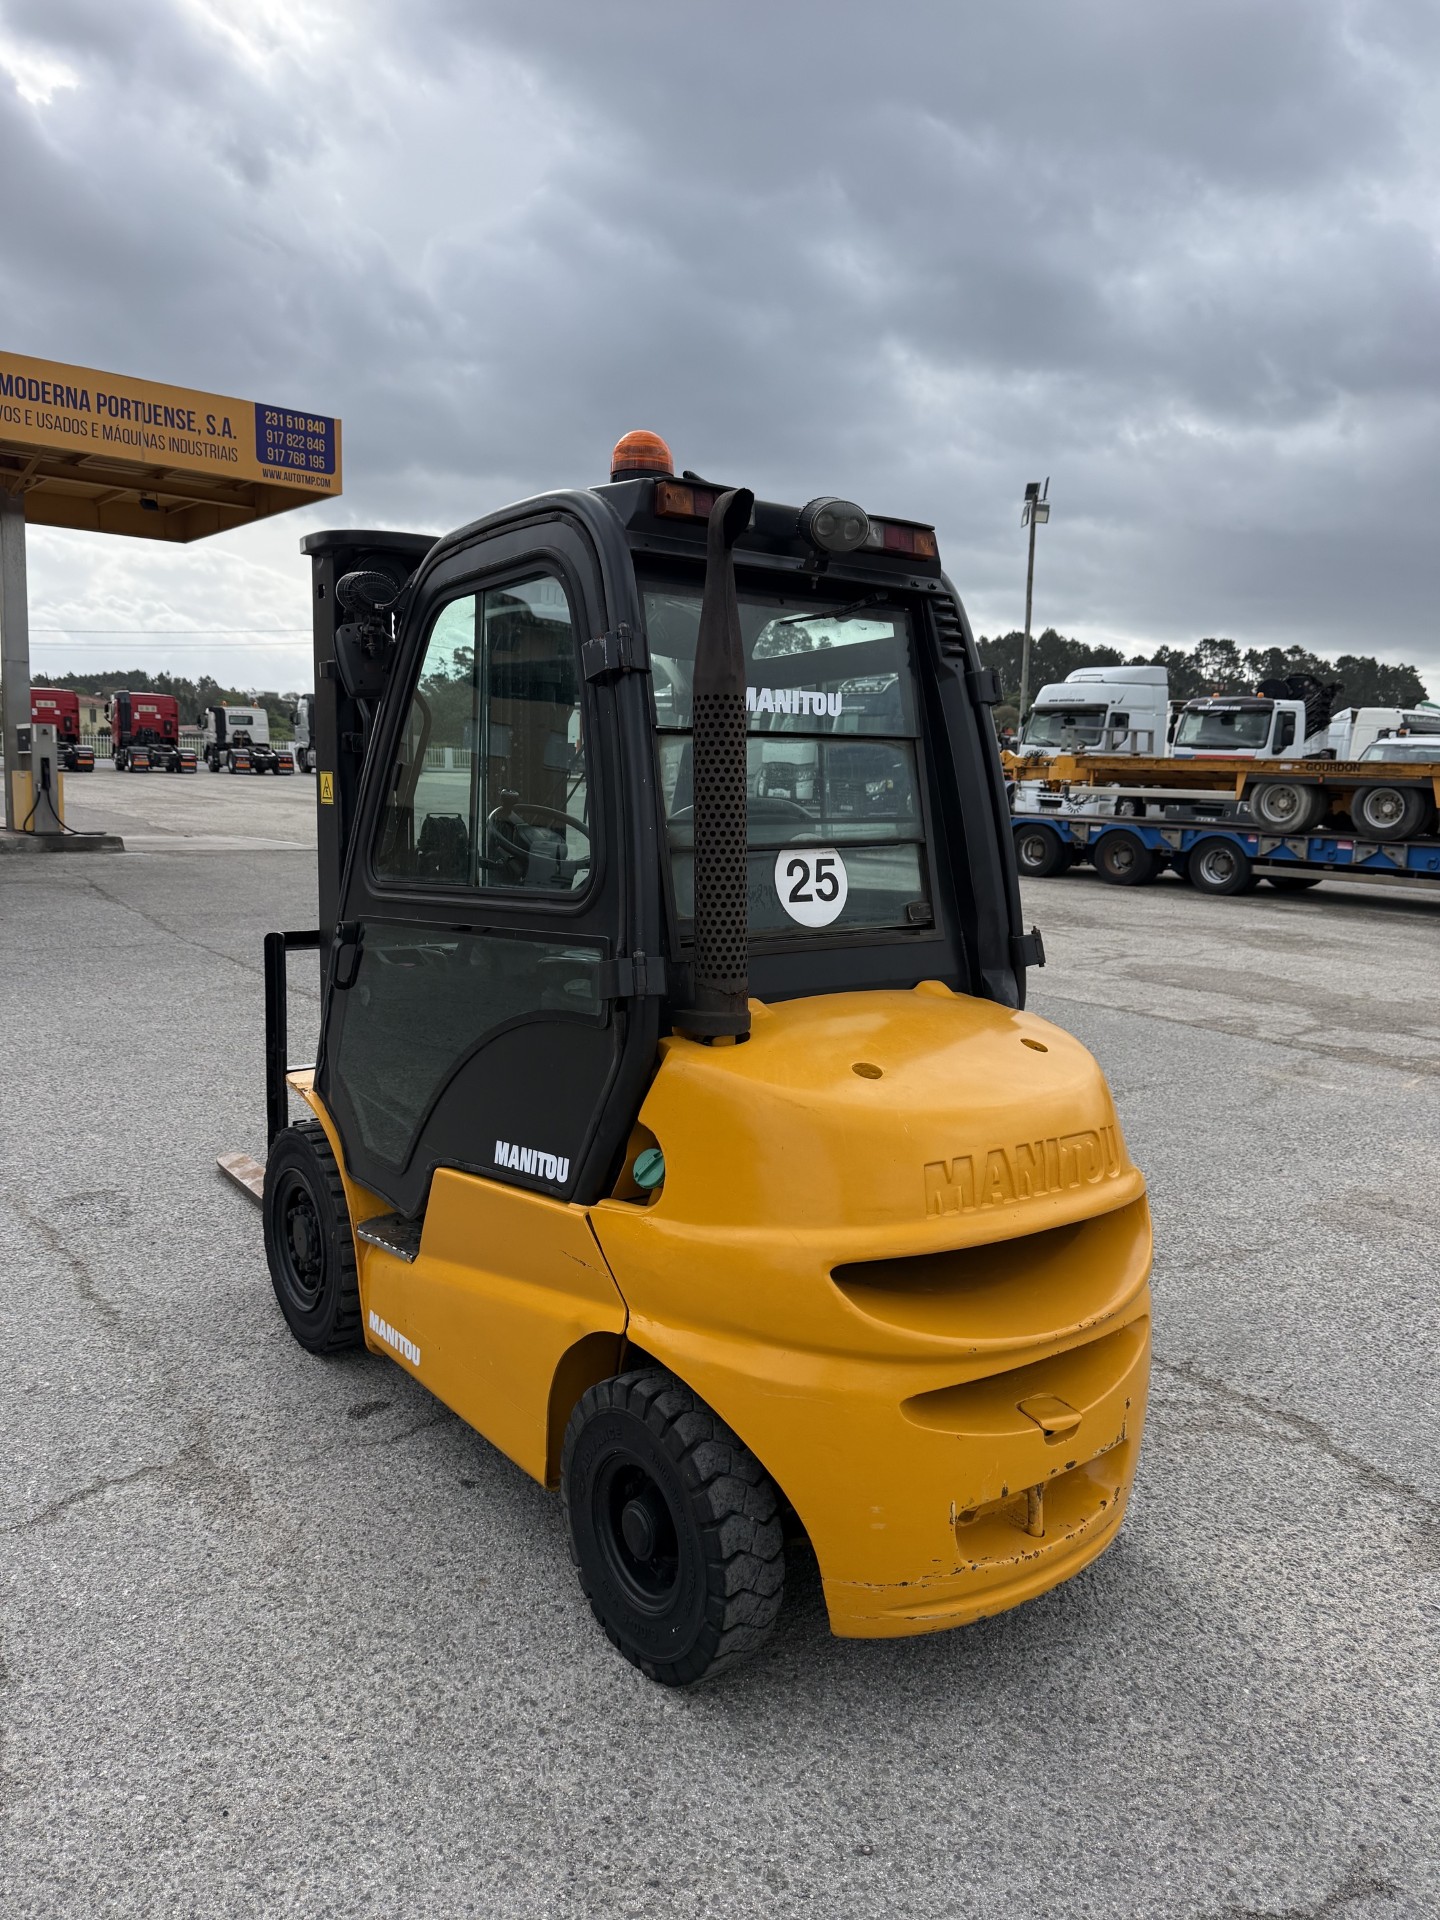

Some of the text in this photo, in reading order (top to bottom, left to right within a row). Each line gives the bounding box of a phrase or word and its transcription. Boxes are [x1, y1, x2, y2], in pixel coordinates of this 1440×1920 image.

[0, 372, 237, 440] MODERNA PORTUENSE, S.A.
[265, 411, 326, 435] 231 510 840
[25, 410, 33, 426] E
[36, 411, 88, 436] USADOS
[91, 422, 99, 438] E
[102, 424, 166, 451] MÁQUINAS
[168, 437, 239, 463] INDUSTRIAIS
[266, 430, 325, 453] 917 822 846
[267, 447, 325, 470] 917 768 195
[262, 468, 331, 488] WWW.AUTOTMP.COM
[1306, 762, 1360, 772] GOURDON
[786, 858, 840, 903] 25
[494, 1140, 570, 1184] MANITOU
[923, 1124, 1122, 1220] MANITOU
[368, 1310, 421, 1367] MANITOU
